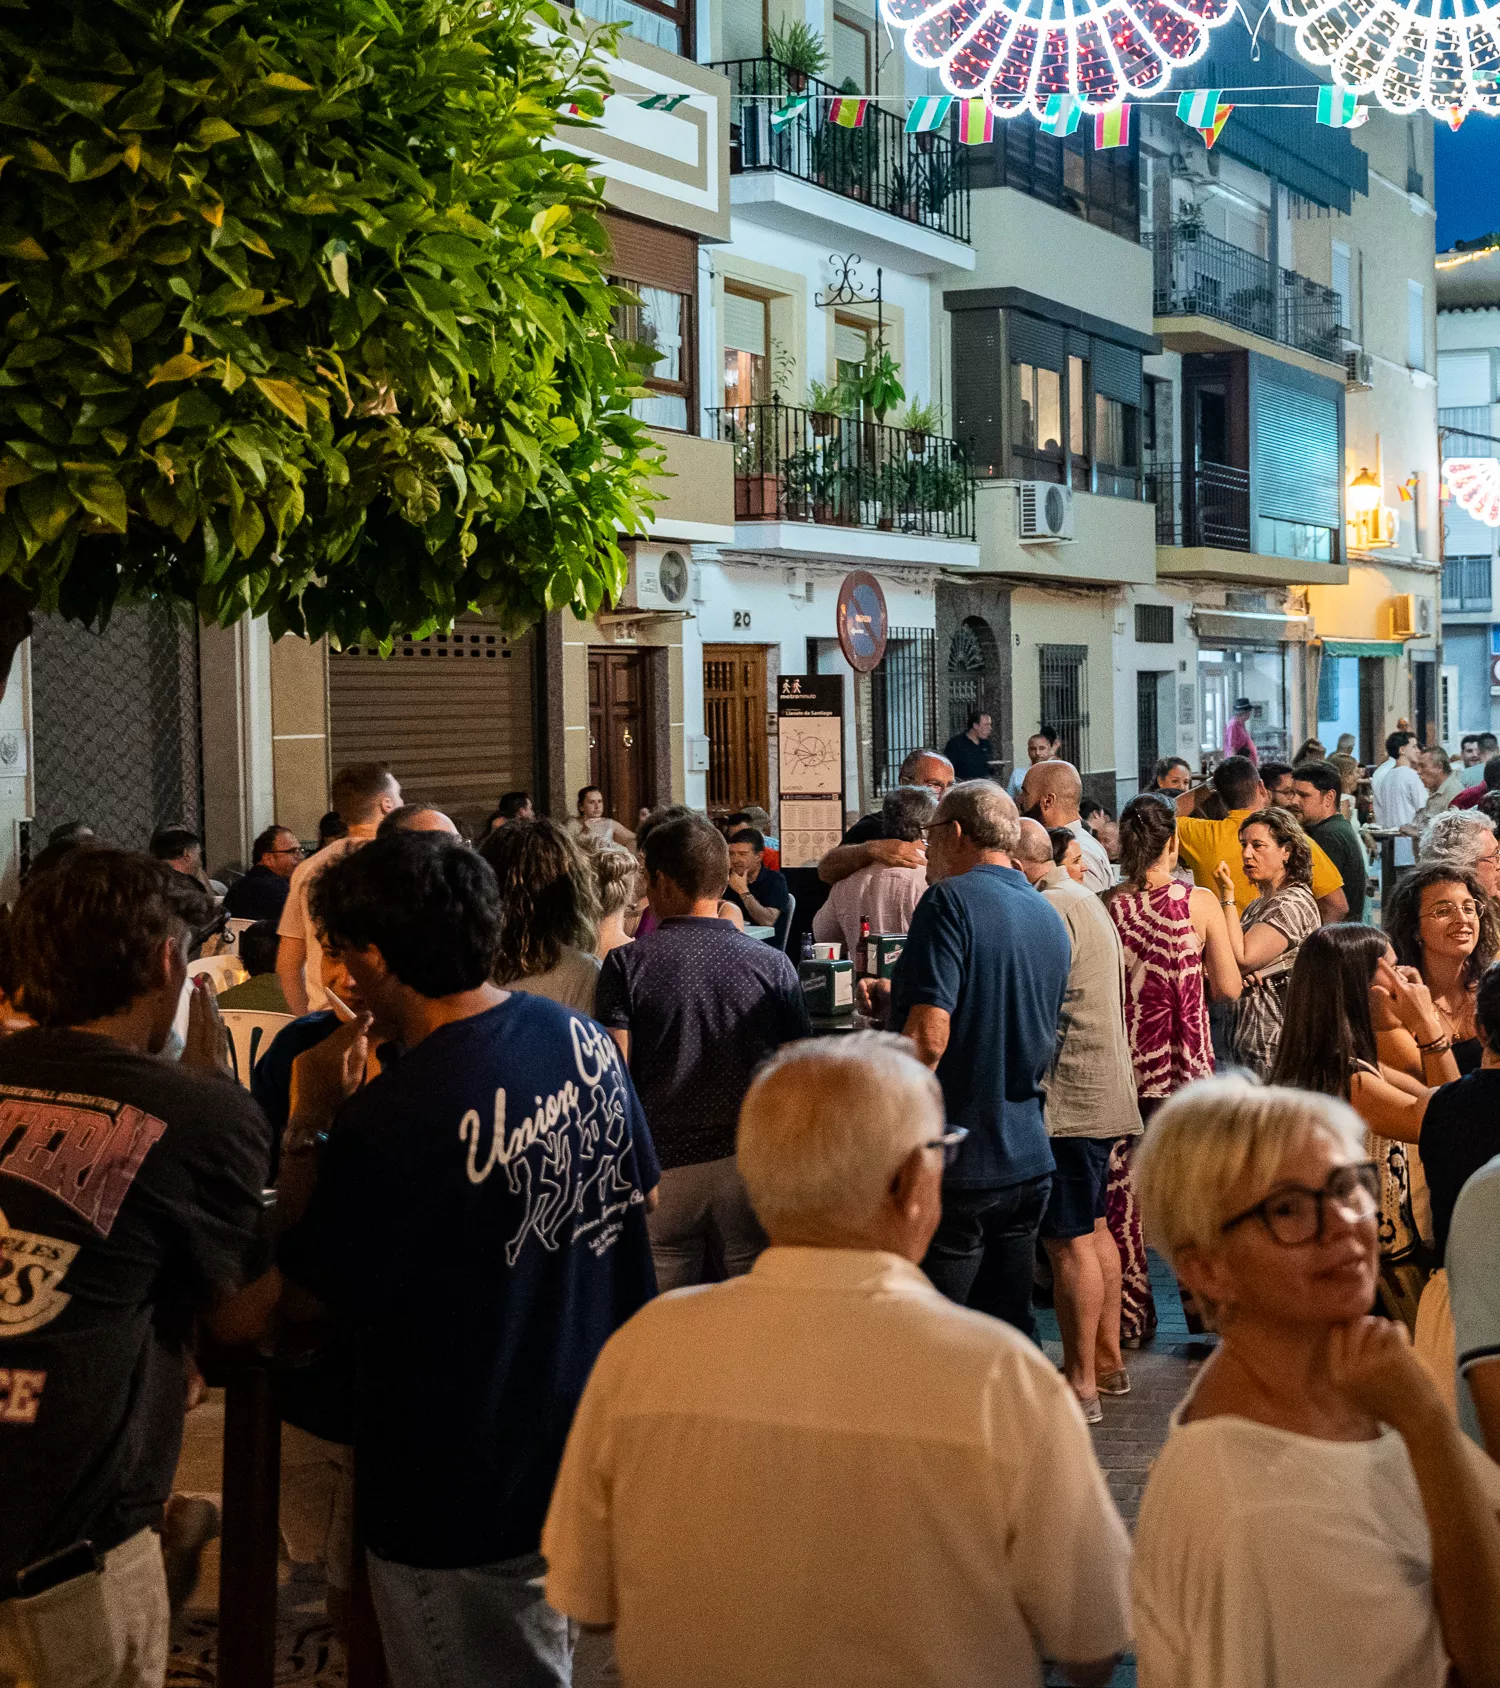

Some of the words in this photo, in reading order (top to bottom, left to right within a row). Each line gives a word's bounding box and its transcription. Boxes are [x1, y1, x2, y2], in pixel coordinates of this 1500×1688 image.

[734, 611, 751, 628] 20
[458, 1080, 580, 1185] Union
[569, 1015, 625, 1087] City
